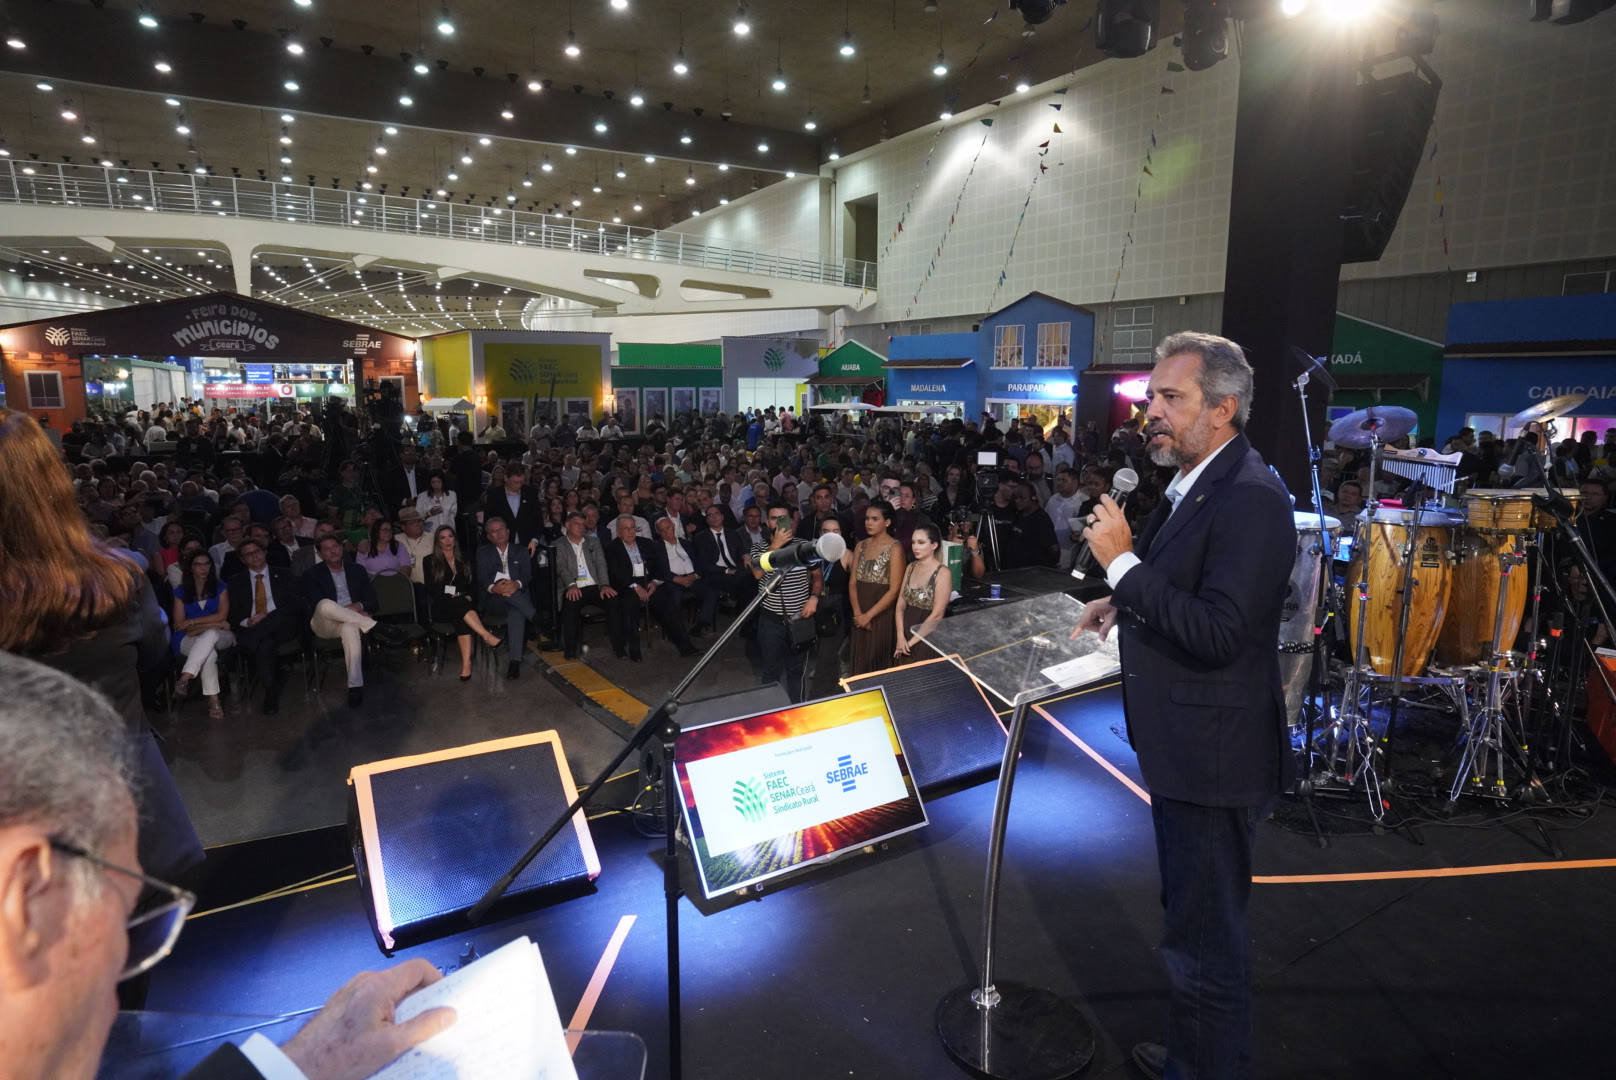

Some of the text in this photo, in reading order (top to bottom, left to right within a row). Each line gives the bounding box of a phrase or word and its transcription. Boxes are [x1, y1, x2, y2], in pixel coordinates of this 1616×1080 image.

[342, 340, 382, 348] SEBRAE
[910, 384, 946, 392] MADALENA
[1008, 383, 1049, 392] PARAIPABA
[763, 770, 785, 779] Sistema
[826, 762, 869, 784] SEBRAE
[766, 776, 790, 791] FAEC
[770, 781, 816, 803] SENAR Ceará
[773, 794, 819, 814] Sindicato Rural
